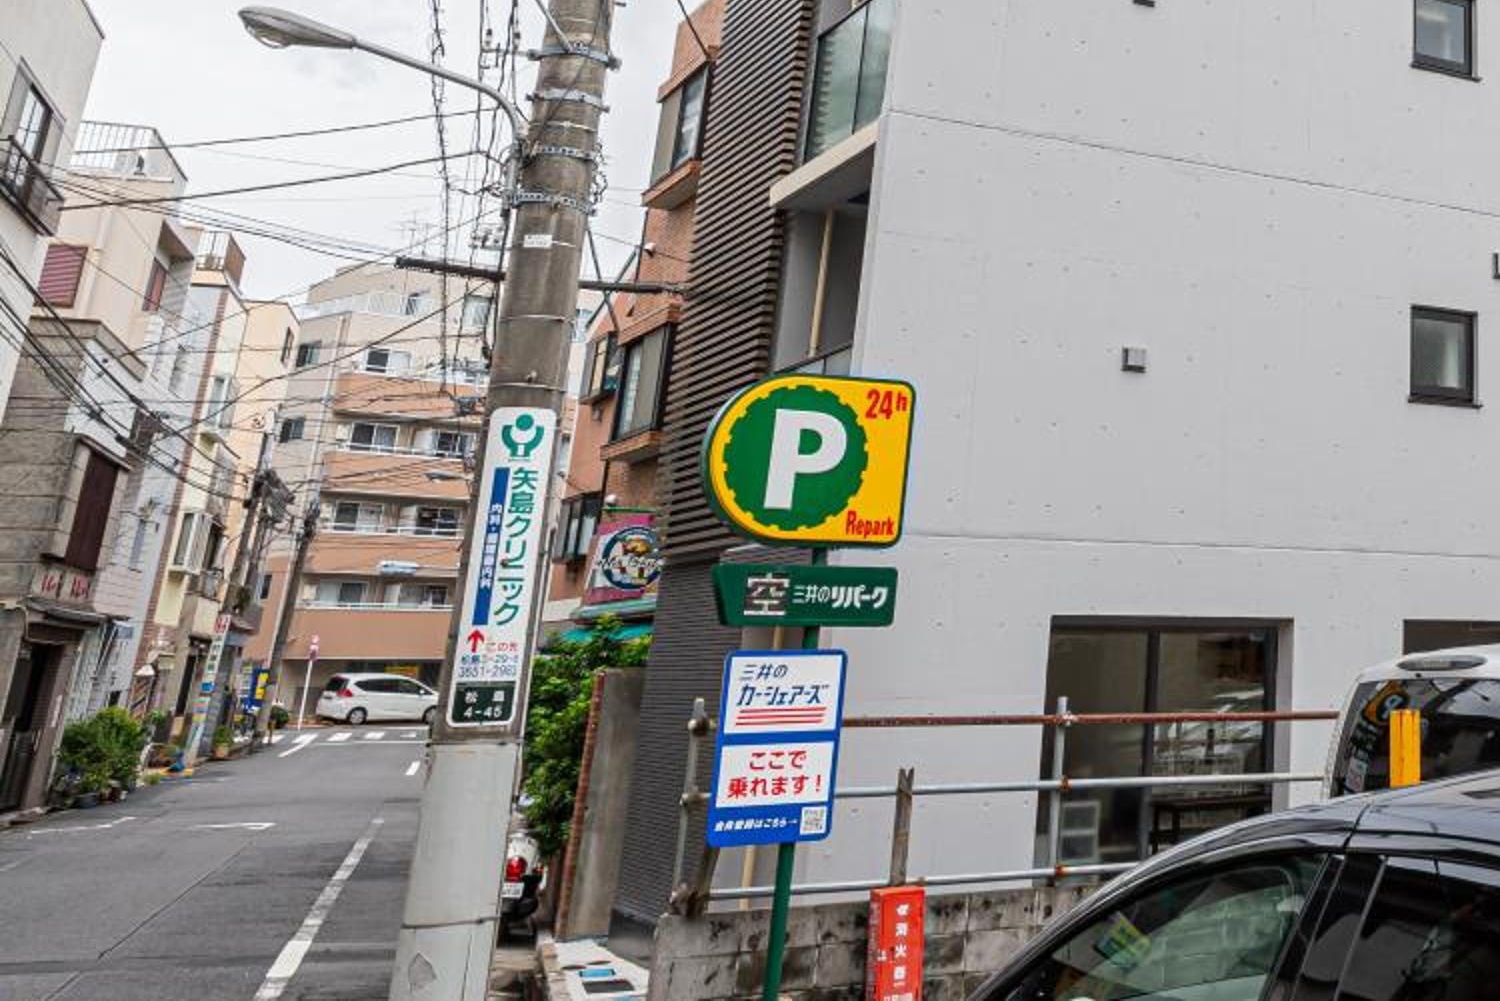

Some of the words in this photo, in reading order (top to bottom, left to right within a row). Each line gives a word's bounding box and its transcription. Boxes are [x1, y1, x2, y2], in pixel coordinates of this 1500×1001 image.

[866, 389, 908, 419] 24h
[763, 408, 847, 510] P
[845, 510, 895, 538] Repark
[493, 467, 538, 626] 矢島クリニック
[743, 572, 790, 616] 空
[793, 584, 888, 609] 三井のリパーク
[740, 663, 789, 681] 三井の
[749, 751, 808, 770] ここで
